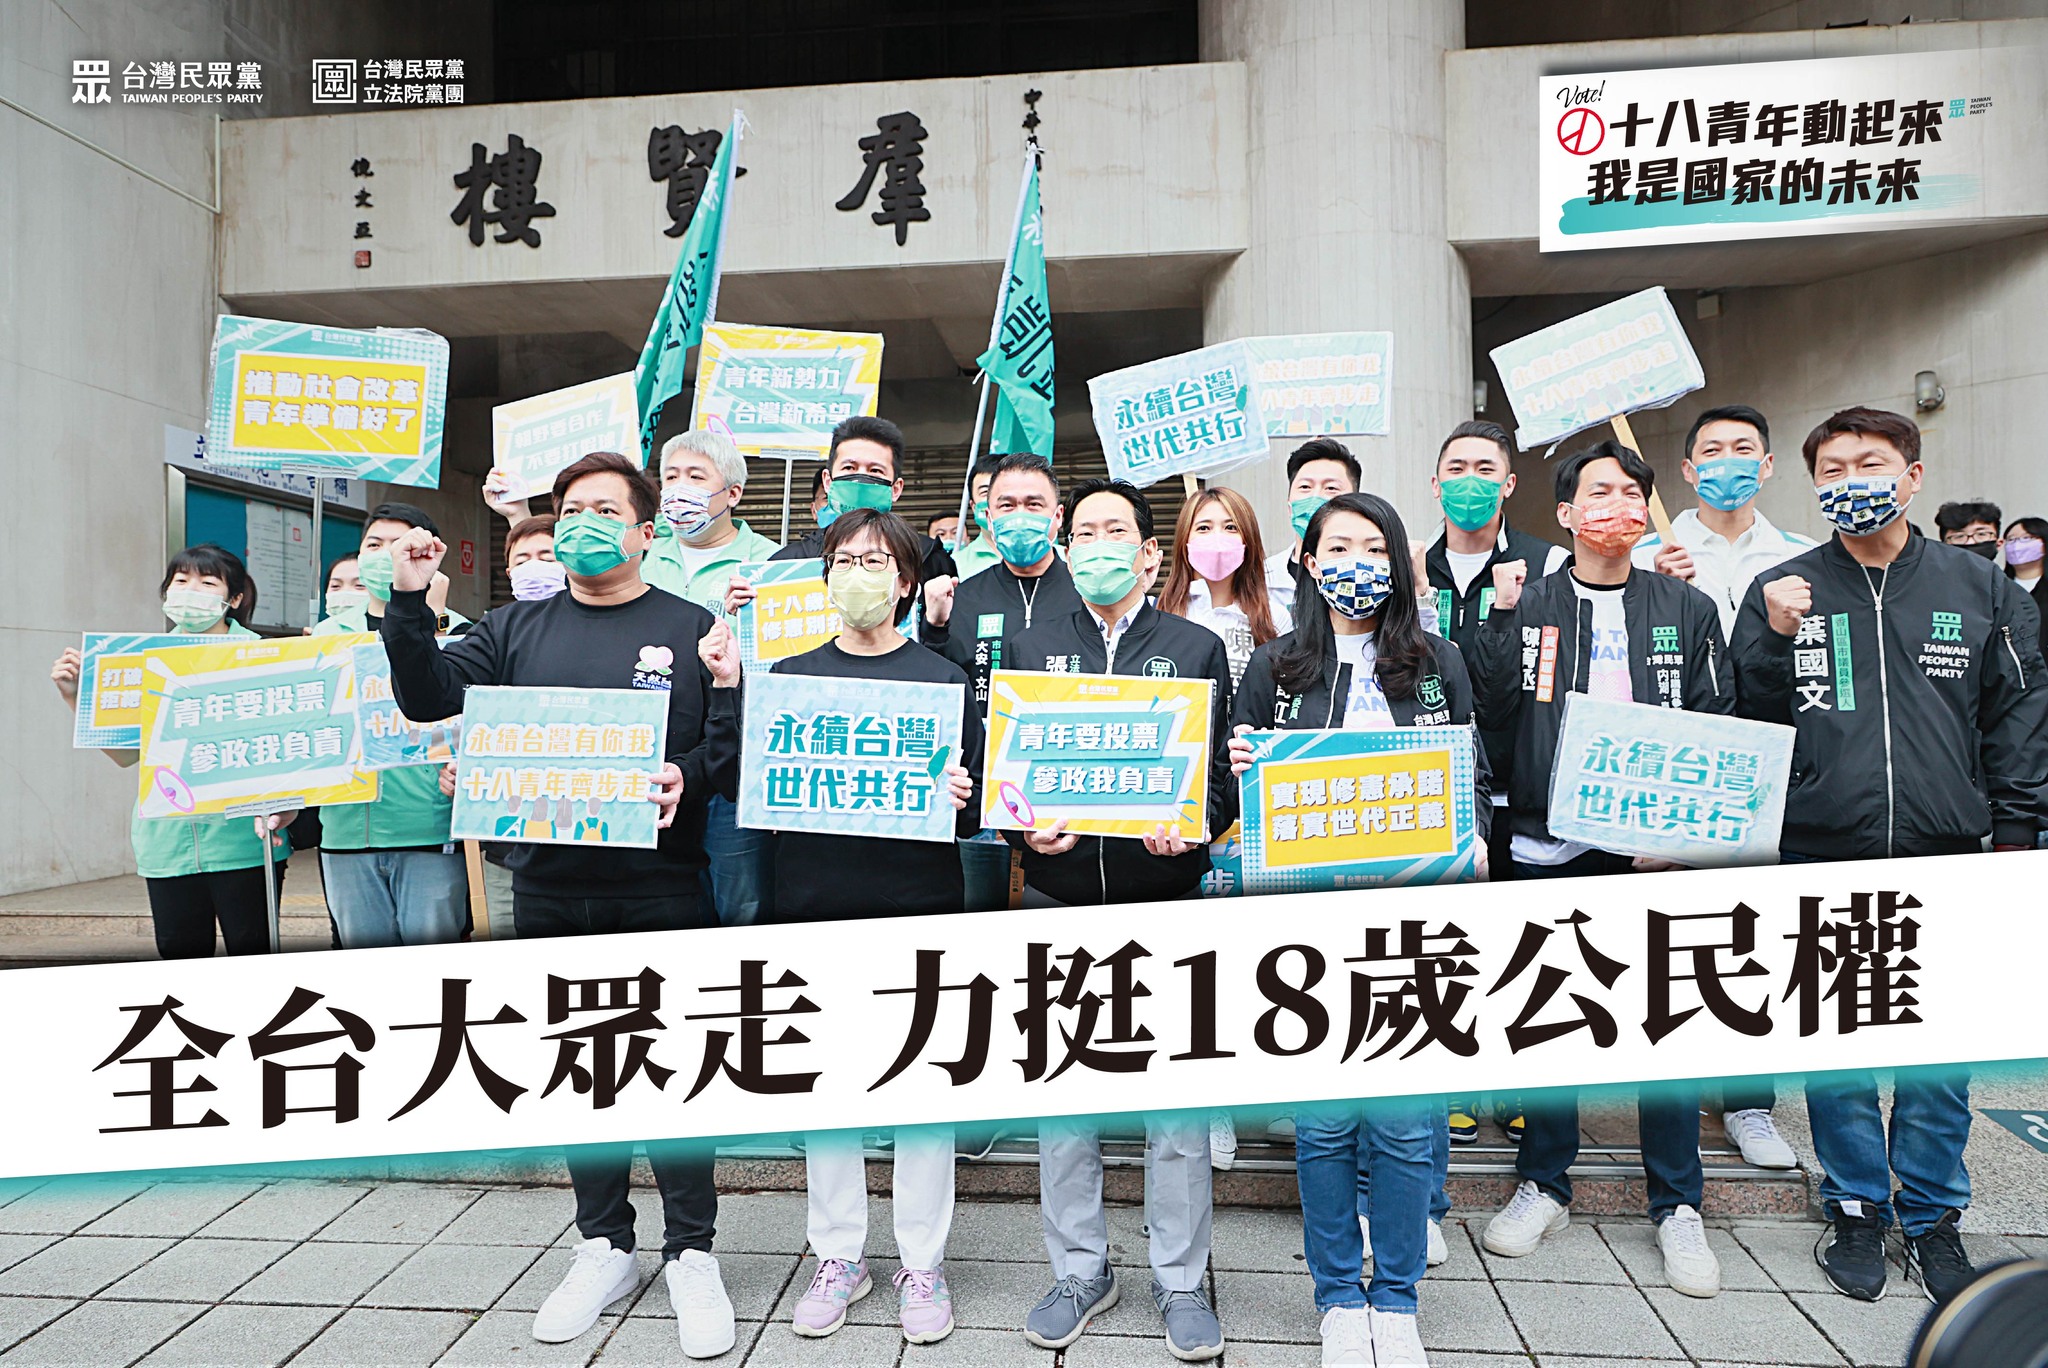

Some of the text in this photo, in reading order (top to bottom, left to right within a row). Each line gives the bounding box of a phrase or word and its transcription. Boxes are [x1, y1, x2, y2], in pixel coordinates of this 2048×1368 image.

[243, 370, 420, 404] 推動社會改革
[724, 365, 841, 390] 青年新勢力
[243, 399, 417, 433] 青年準備好了
[734, 401, 852, 425] 台灣新希望
[1114, 367, 1237, 431] 永續台灣
[1122, 408, 1244, 469] 世代共行
[1652, 626, 1680, 653] 眾
[1931, 611, 1963, 642] 眾
[1794, 614, 1832, 714] 葉國文
[1918, 654, 1970, 668] PEOPLE'S
[1922, 643, 1971, 657] TAIWAN
[1925, 667, 1965, 680] PARTY
[173, 679, 326, 729] 青年要投票
[190, 726, 343, 774] 參政我負責
[468, 727, 652, 754] 永續台灣有你我
[767, 713, 936, 758] 永續台灣
[1018, 721, 1160, 751] 青年要投票
[1032, 765, 1174, 795] 參政我負責
[1582, 736, 1760, 792] 永續台灣
[465, 770, 648, 799] 十八青年齊步走
[766, 767, 932, 812] 世代共行
[1270, 768, 1445, 810] 實現修憲承諾
[1271, 801, 1446, 842] 落實世代正義
[1577, 784, 1750, 842] 世代共行
